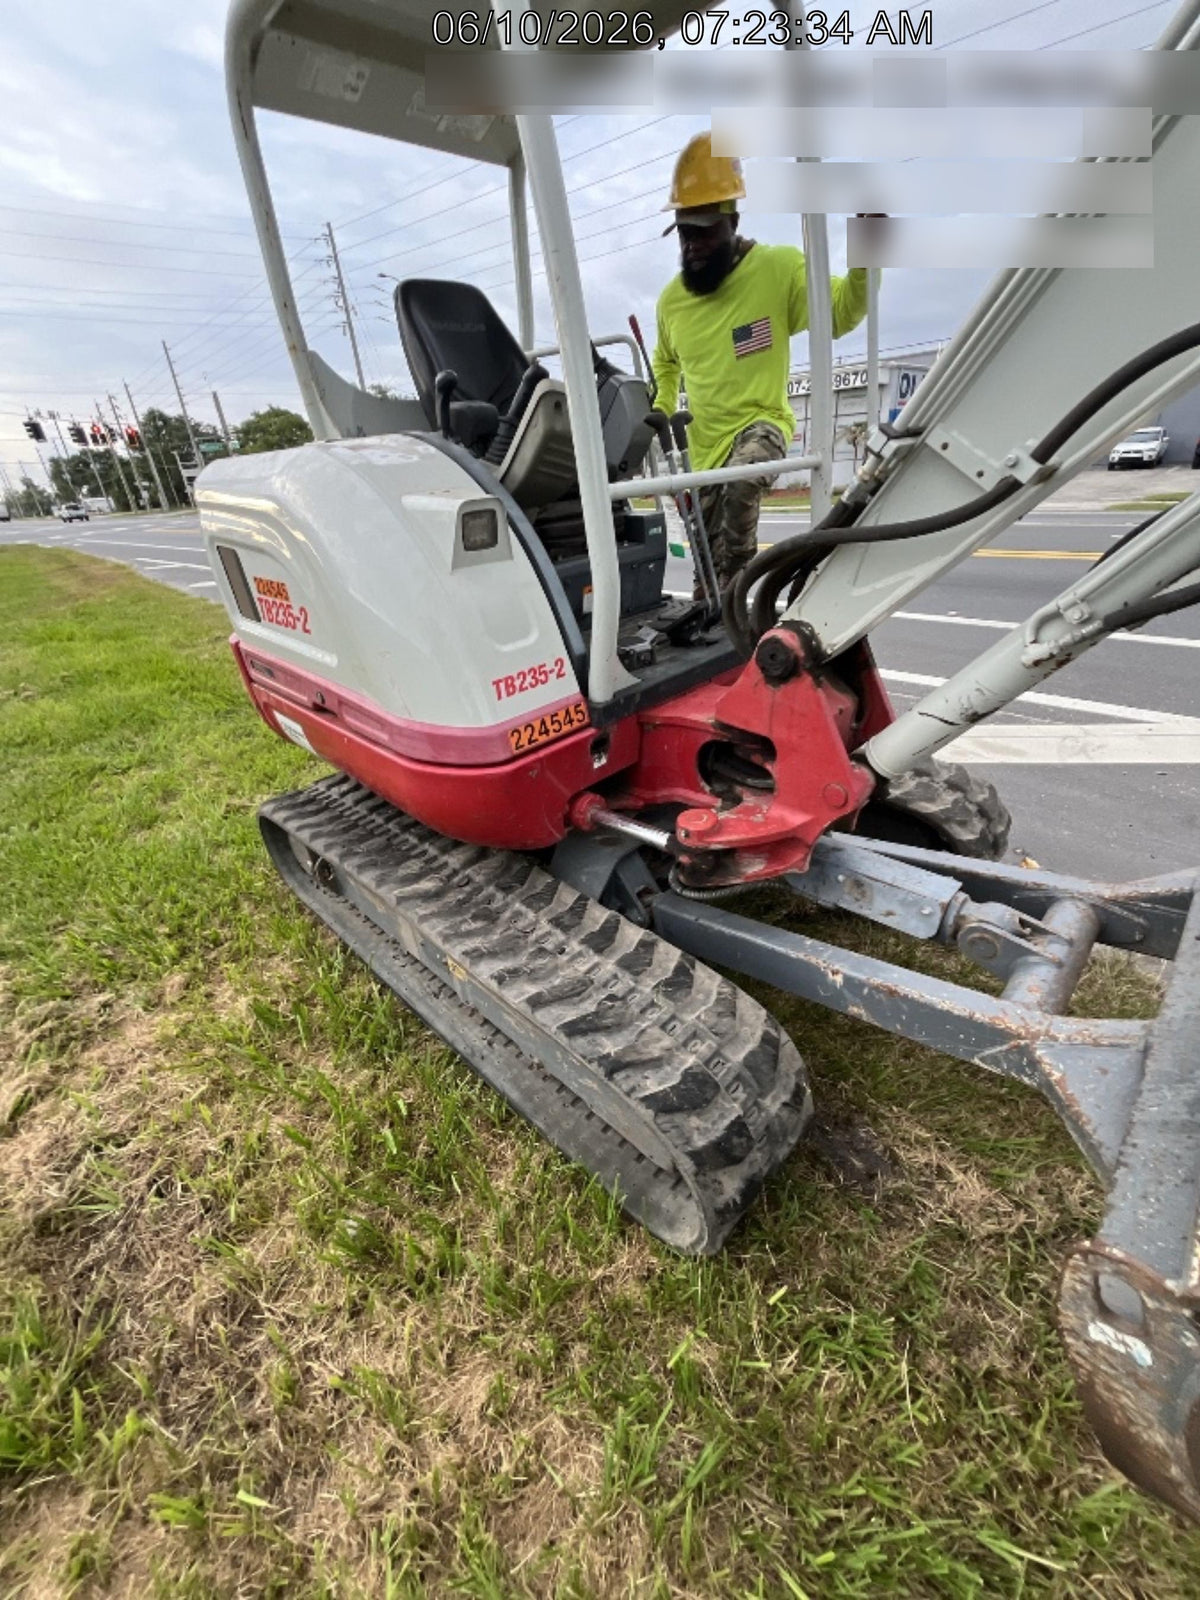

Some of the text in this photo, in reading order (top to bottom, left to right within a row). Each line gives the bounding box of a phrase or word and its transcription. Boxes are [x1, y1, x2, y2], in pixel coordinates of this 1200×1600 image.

[257, 597, 312, 635] TB235-2
[492, 657, 566, 701] TB235-2
[510, 703, 586, 751] 224545
